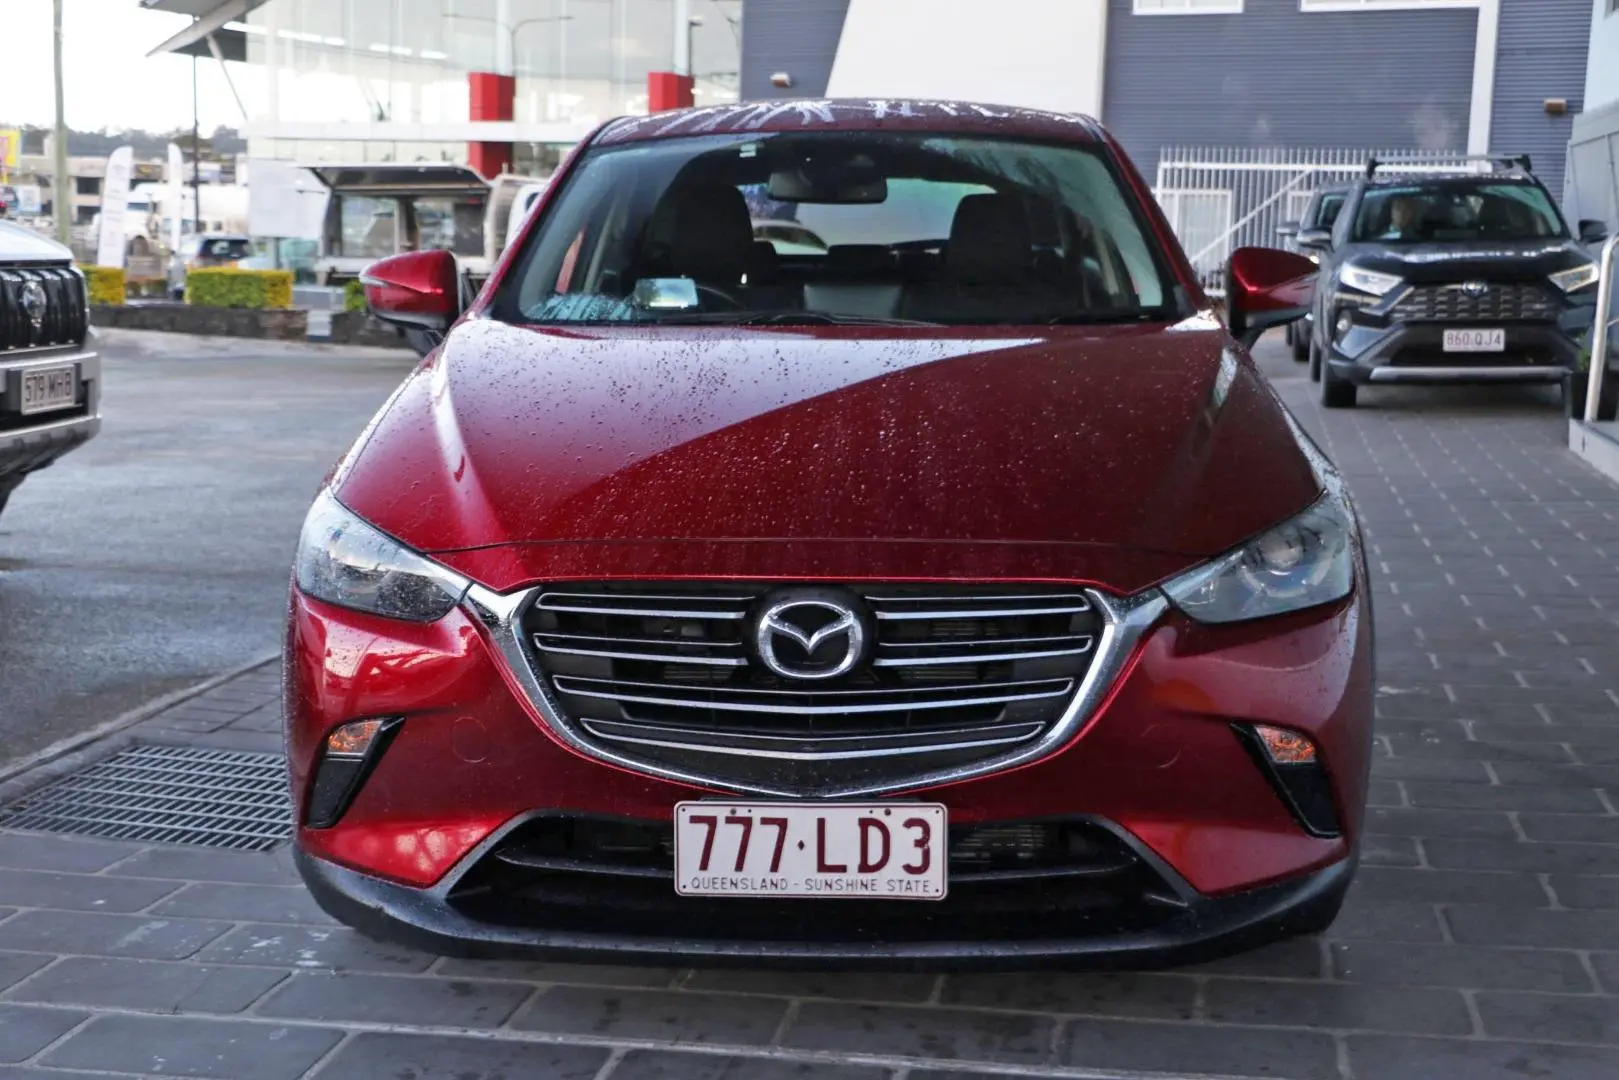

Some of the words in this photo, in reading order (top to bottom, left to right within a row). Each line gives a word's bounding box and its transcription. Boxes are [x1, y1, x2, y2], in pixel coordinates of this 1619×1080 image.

[690, 877, 788, 890] QUEENSLAND
[805, 878, 878, 892] SUNSHINE
[887, 879, 930, 893] STATE
